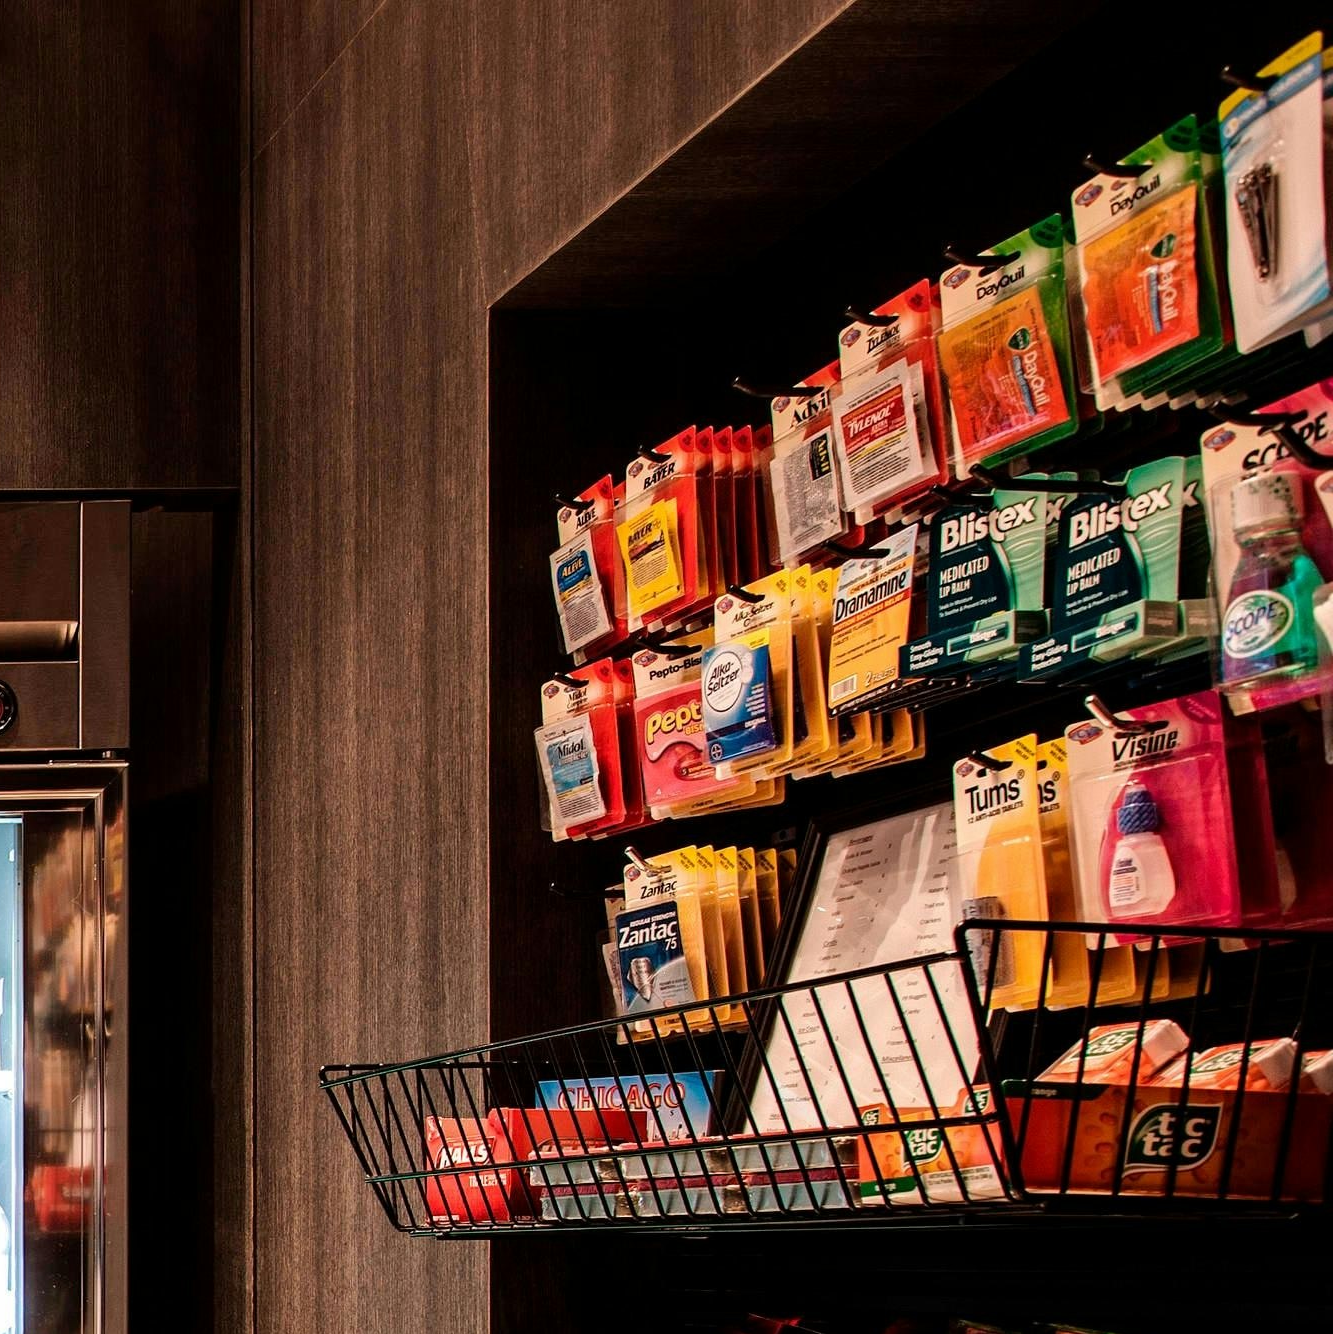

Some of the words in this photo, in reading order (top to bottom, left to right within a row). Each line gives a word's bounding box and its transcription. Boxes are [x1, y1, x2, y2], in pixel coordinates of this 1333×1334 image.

[1110, 175, 1161, 216] DayQuil
[976, 266, 1025, 299] DayQuil
[1024, 350, 1051, 408] DayQuil
[789, 392, 830, 428] Advil
[848, 402, 895, 438] TYLENOL
[644, 463, 676, 490] BAYER
[575, 508, 597, 529] ALEVE
[939, 497, 1036, 554] Blistex
[1068, 482, 1172, 549] Blistex
[561, 556, 585, 578] ALEVE
[939, 556, 989, 585] MEDICATED
[1067, 547, 1121, 582] MEDICATED
[834, 571, 908, 621] Dramamine
[938, 582, 952, 599] LIP
[952, 579, 972, 596] BALM
[1066, 579, 1080, 596] LIP
[1081, 573, 1101, 591] BALM
[1225, 602, 1278, 642] SCOPE
[708, 667, 741, 697] Seltzer
[557, 737, 587, 760] Midol
[1112, 728, 1179, 761] Visine
[965, 777, 1021, 815] Tums
[1002, 800, 1024, 816] TABLETS
[640, 879, 678, 899] Zantac
[619, 919, 679, 950] Zantac
[665, 936, 679, 951] 75
[557, 1080, 687, 1110] CHICAGO
[437, 1144, 493, 1168] HALLS
